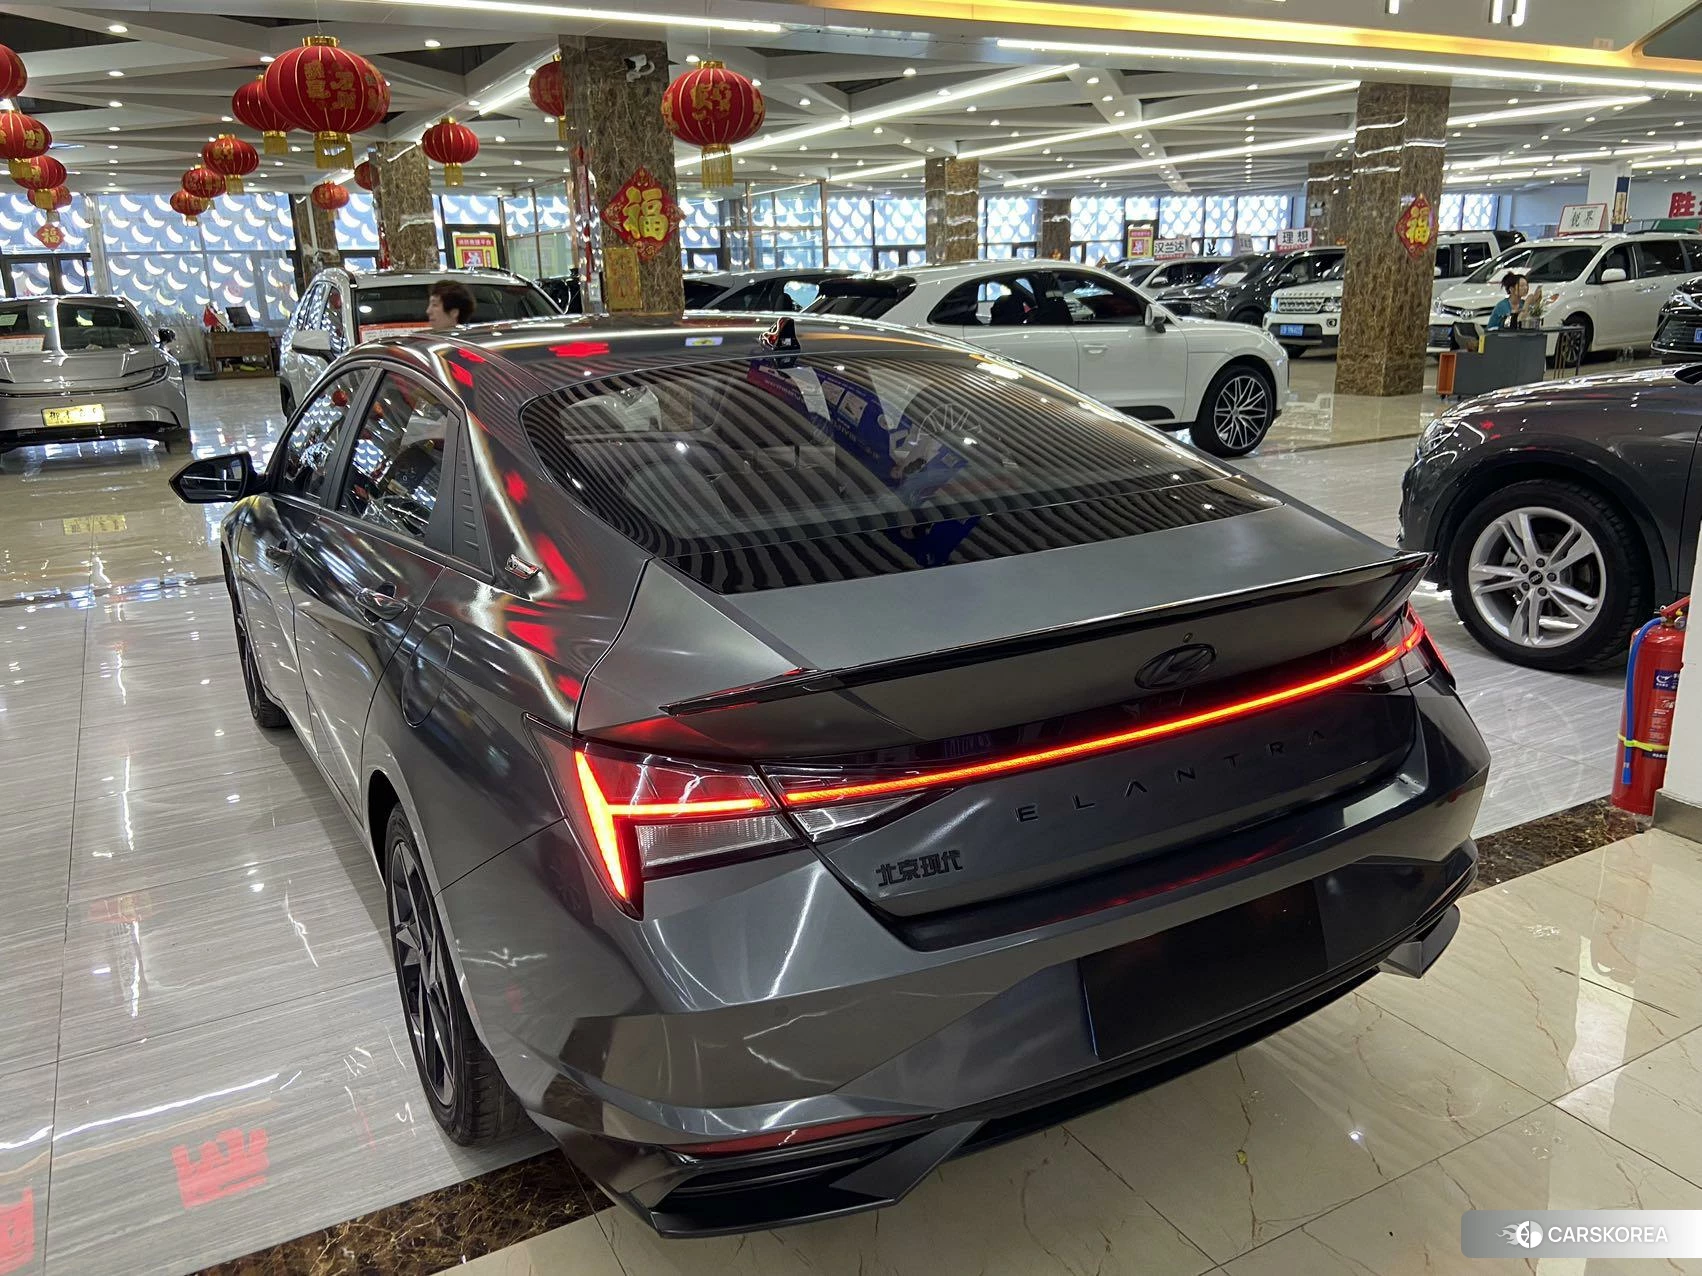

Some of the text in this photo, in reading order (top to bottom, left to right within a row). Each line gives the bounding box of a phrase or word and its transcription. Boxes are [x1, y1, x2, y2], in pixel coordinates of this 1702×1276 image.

[623, 186, 669, 241] 福
[1668, 191, 1702, 218] 胜
[41, 228, 60, 243] 福
[1282, 231, 1309, 244] 理想
[1406, 206, 1430, 245] 福
[1155, 241, 1184, 254] 汉兰达
[1015, 730, 1325, 822] ELANTRA
[875, 850, 963, 886] 北京现代
